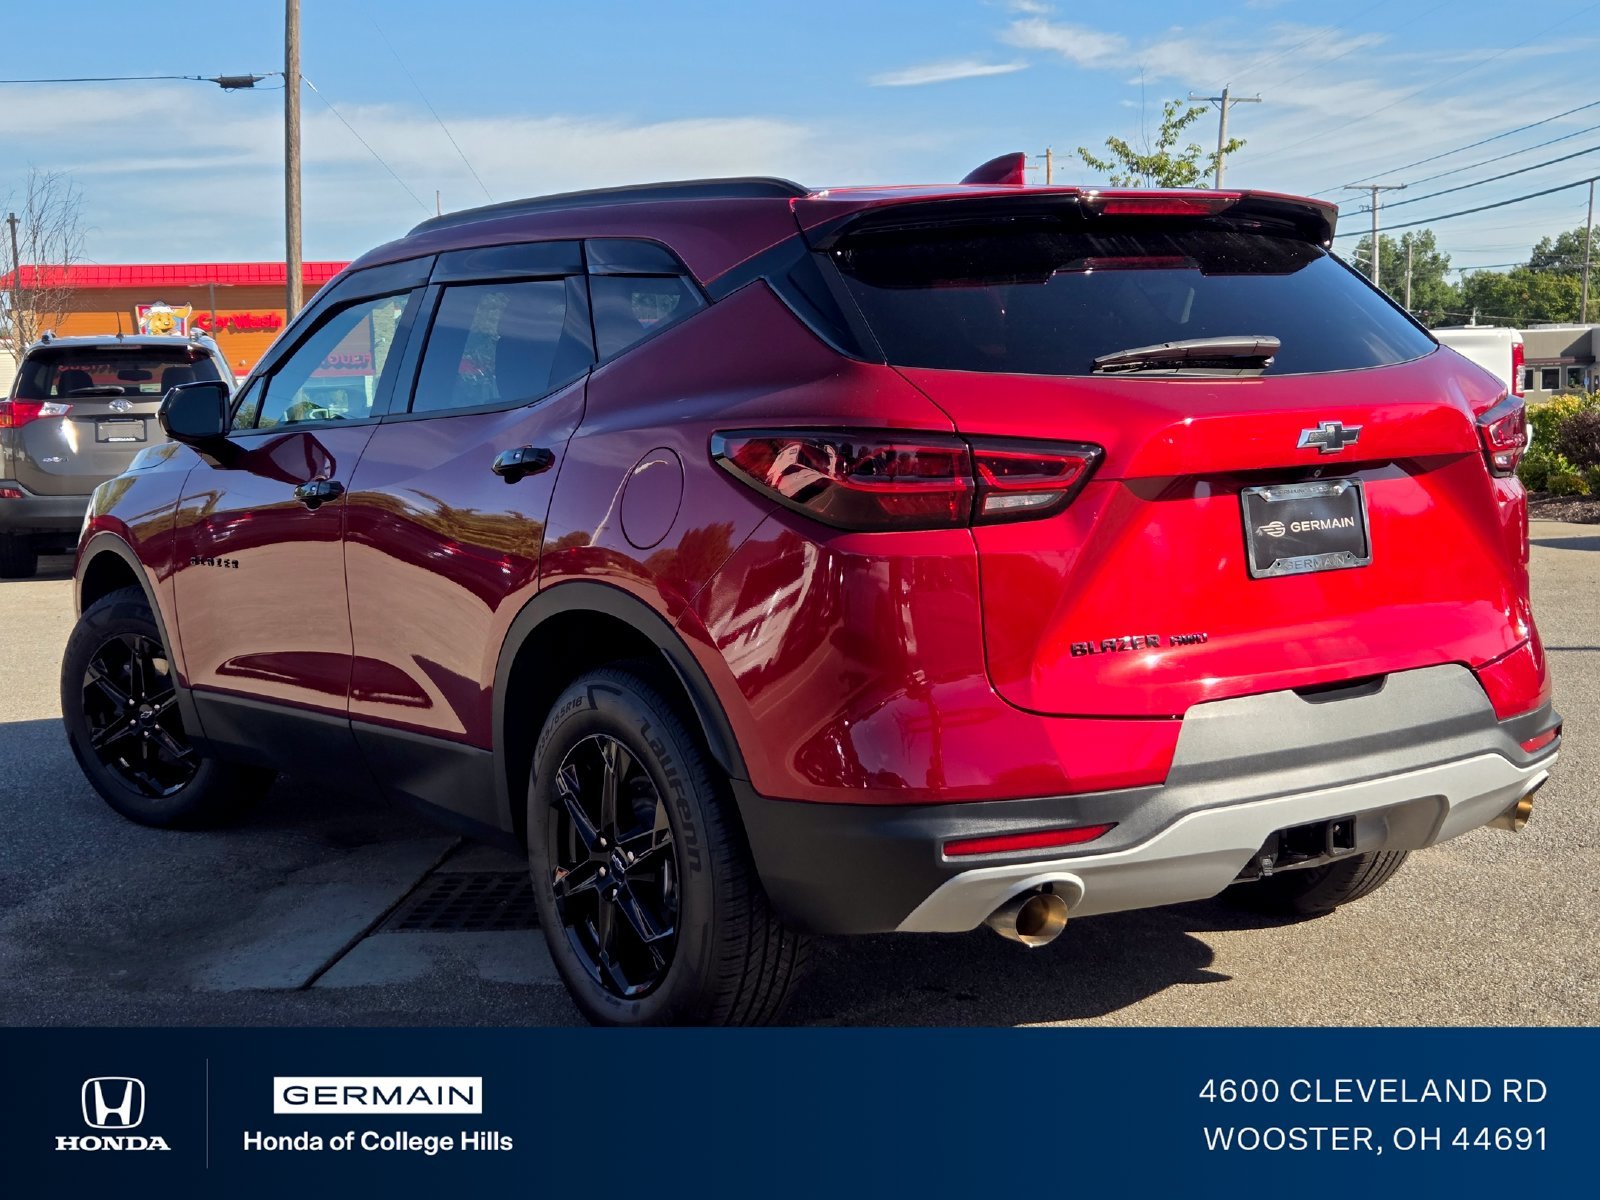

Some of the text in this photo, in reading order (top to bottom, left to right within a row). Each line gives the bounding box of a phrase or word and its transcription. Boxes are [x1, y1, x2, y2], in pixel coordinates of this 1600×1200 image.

[1290, 516, 1355, 533] GERMAIN
[1284, 555, 1346, 571] GERMAIN
[1070, 632, 1208, 658] BLAZER AWD
[640, 716, 703, 873] Laufenn
